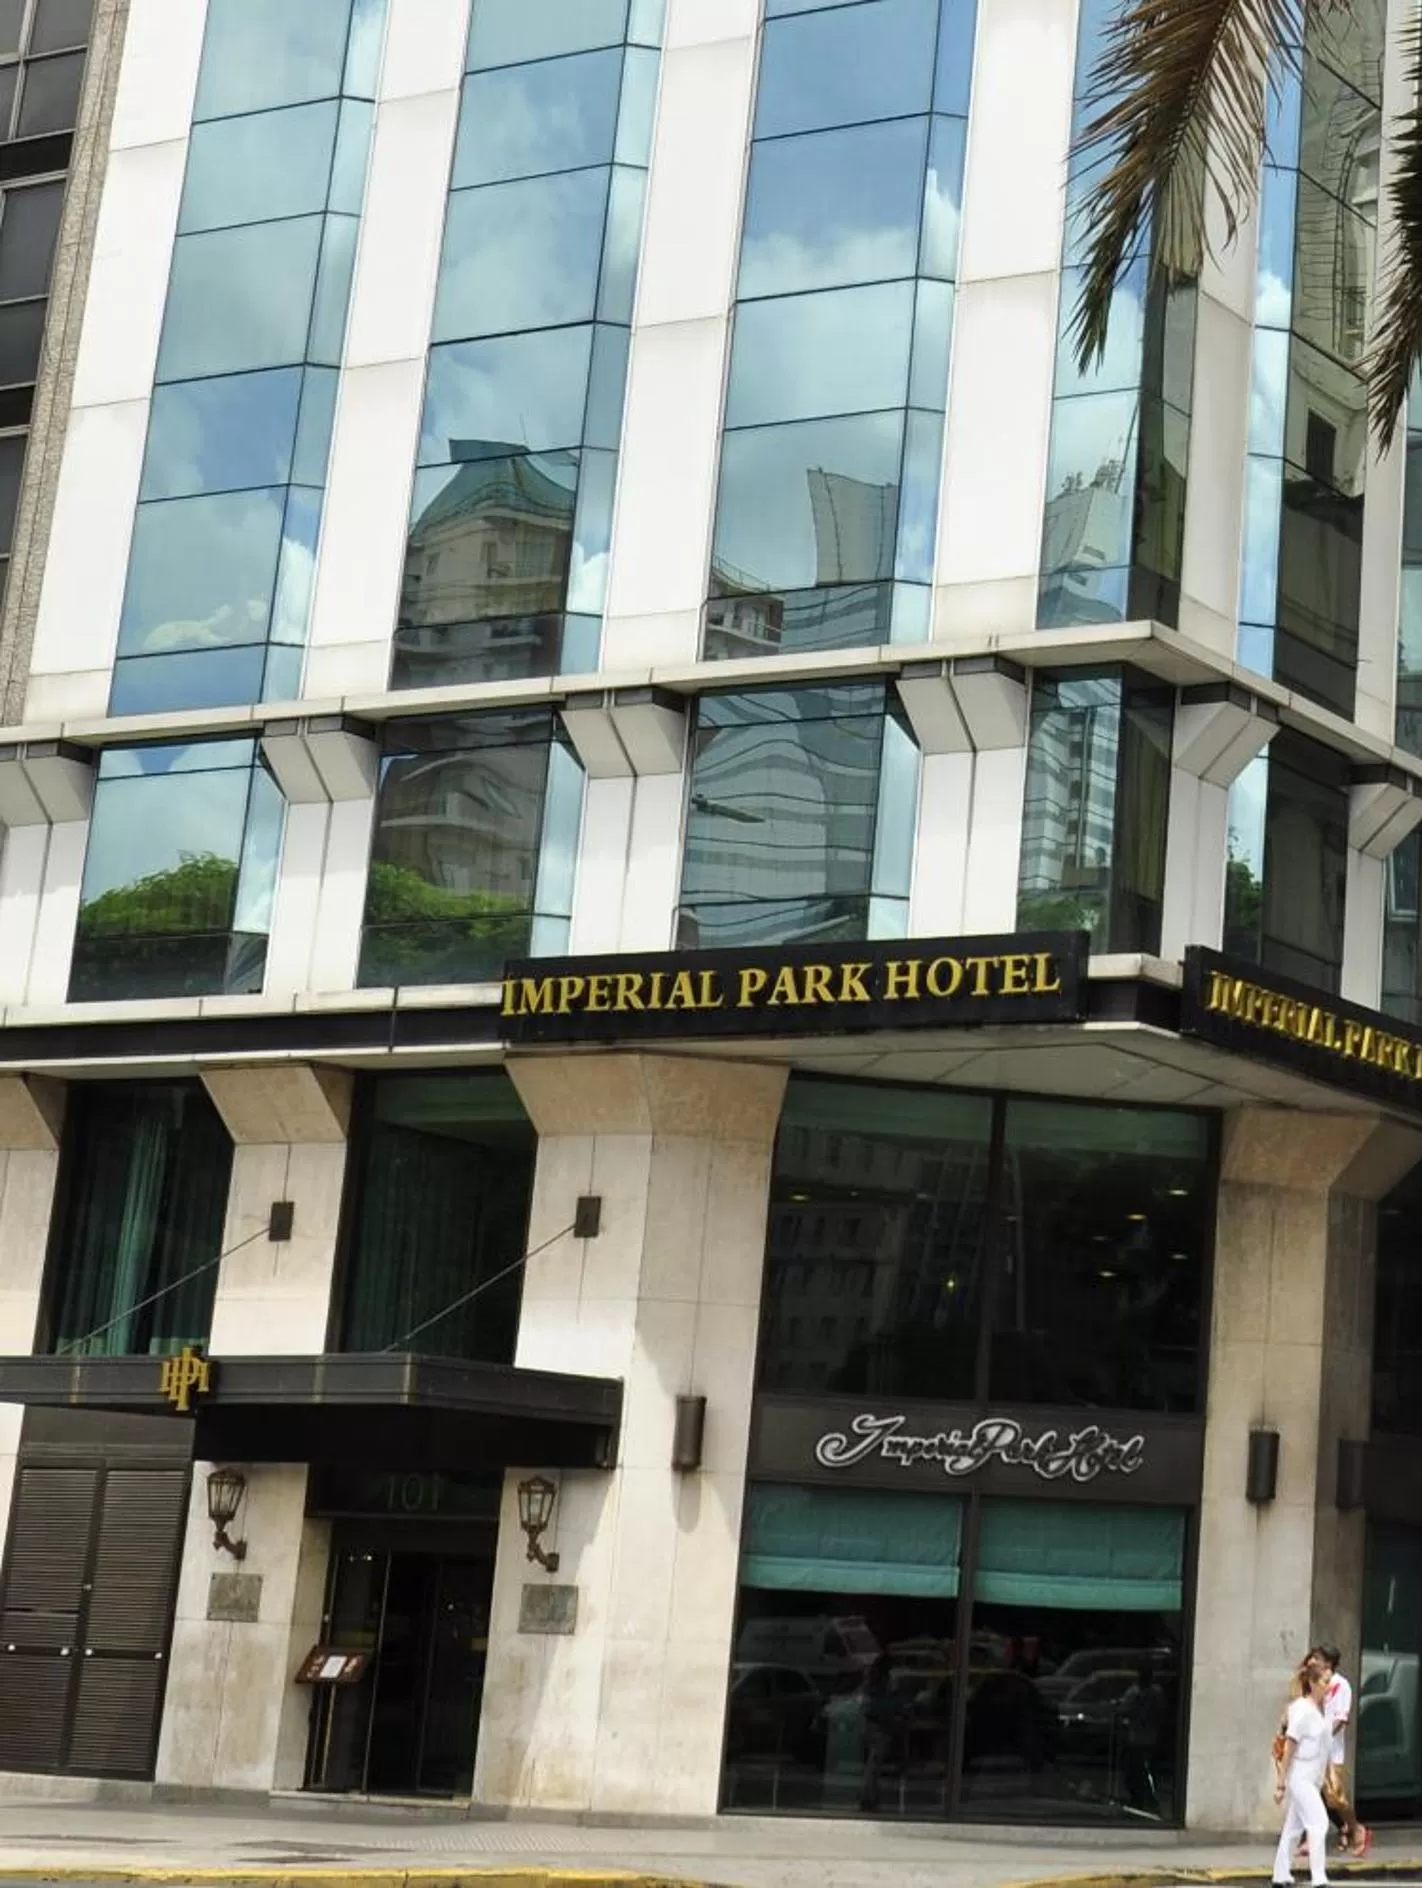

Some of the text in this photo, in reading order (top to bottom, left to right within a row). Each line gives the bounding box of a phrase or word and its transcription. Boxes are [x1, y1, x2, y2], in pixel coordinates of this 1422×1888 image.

[500, 952, 1062, 1016] IMPERIAL PARK HOTEL
[1206, 969, 1342, 1050] IMPERIAL
[1343, 1019, 1413, 1079] PARK
[387, 1472, 442, 1513] 101
